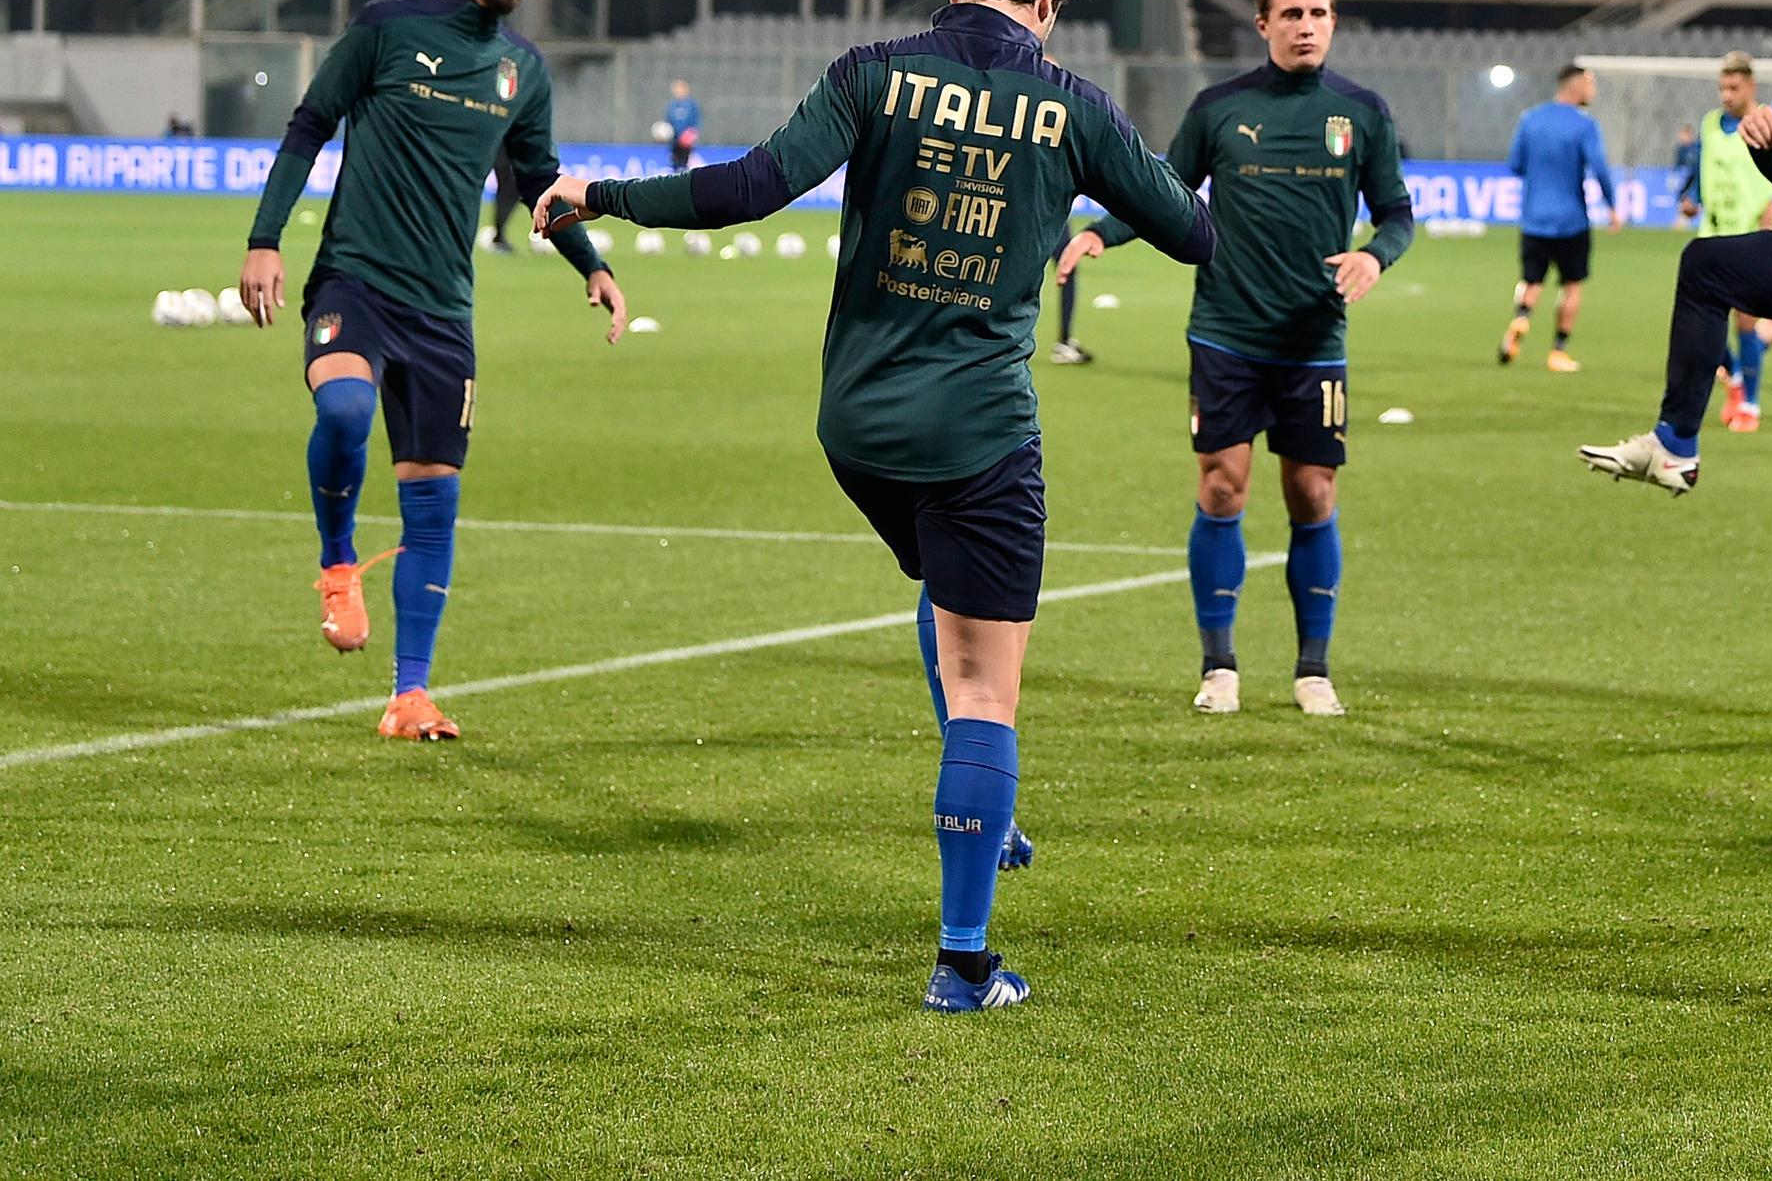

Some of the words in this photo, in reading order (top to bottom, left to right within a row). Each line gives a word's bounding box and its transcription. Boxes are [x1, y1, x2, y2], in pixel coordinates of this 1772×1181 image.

[883, 70, 1067, 148] ITALIA
[65, 143, 218, 190] RIPARTE
[961, 145, 1012, 182] TV
[911, 196, 932, 215] FIAT
[955, 179, 1004, 196] TIMVISION
[942, 192, 1007, 239] FIAT
[934, 245, 1005, 286] eni
[876, 270, 992, 311] Posteitaliane
[1321, 380, 1345, 427] 16
[934, 813, 982, 831] ITALIA
